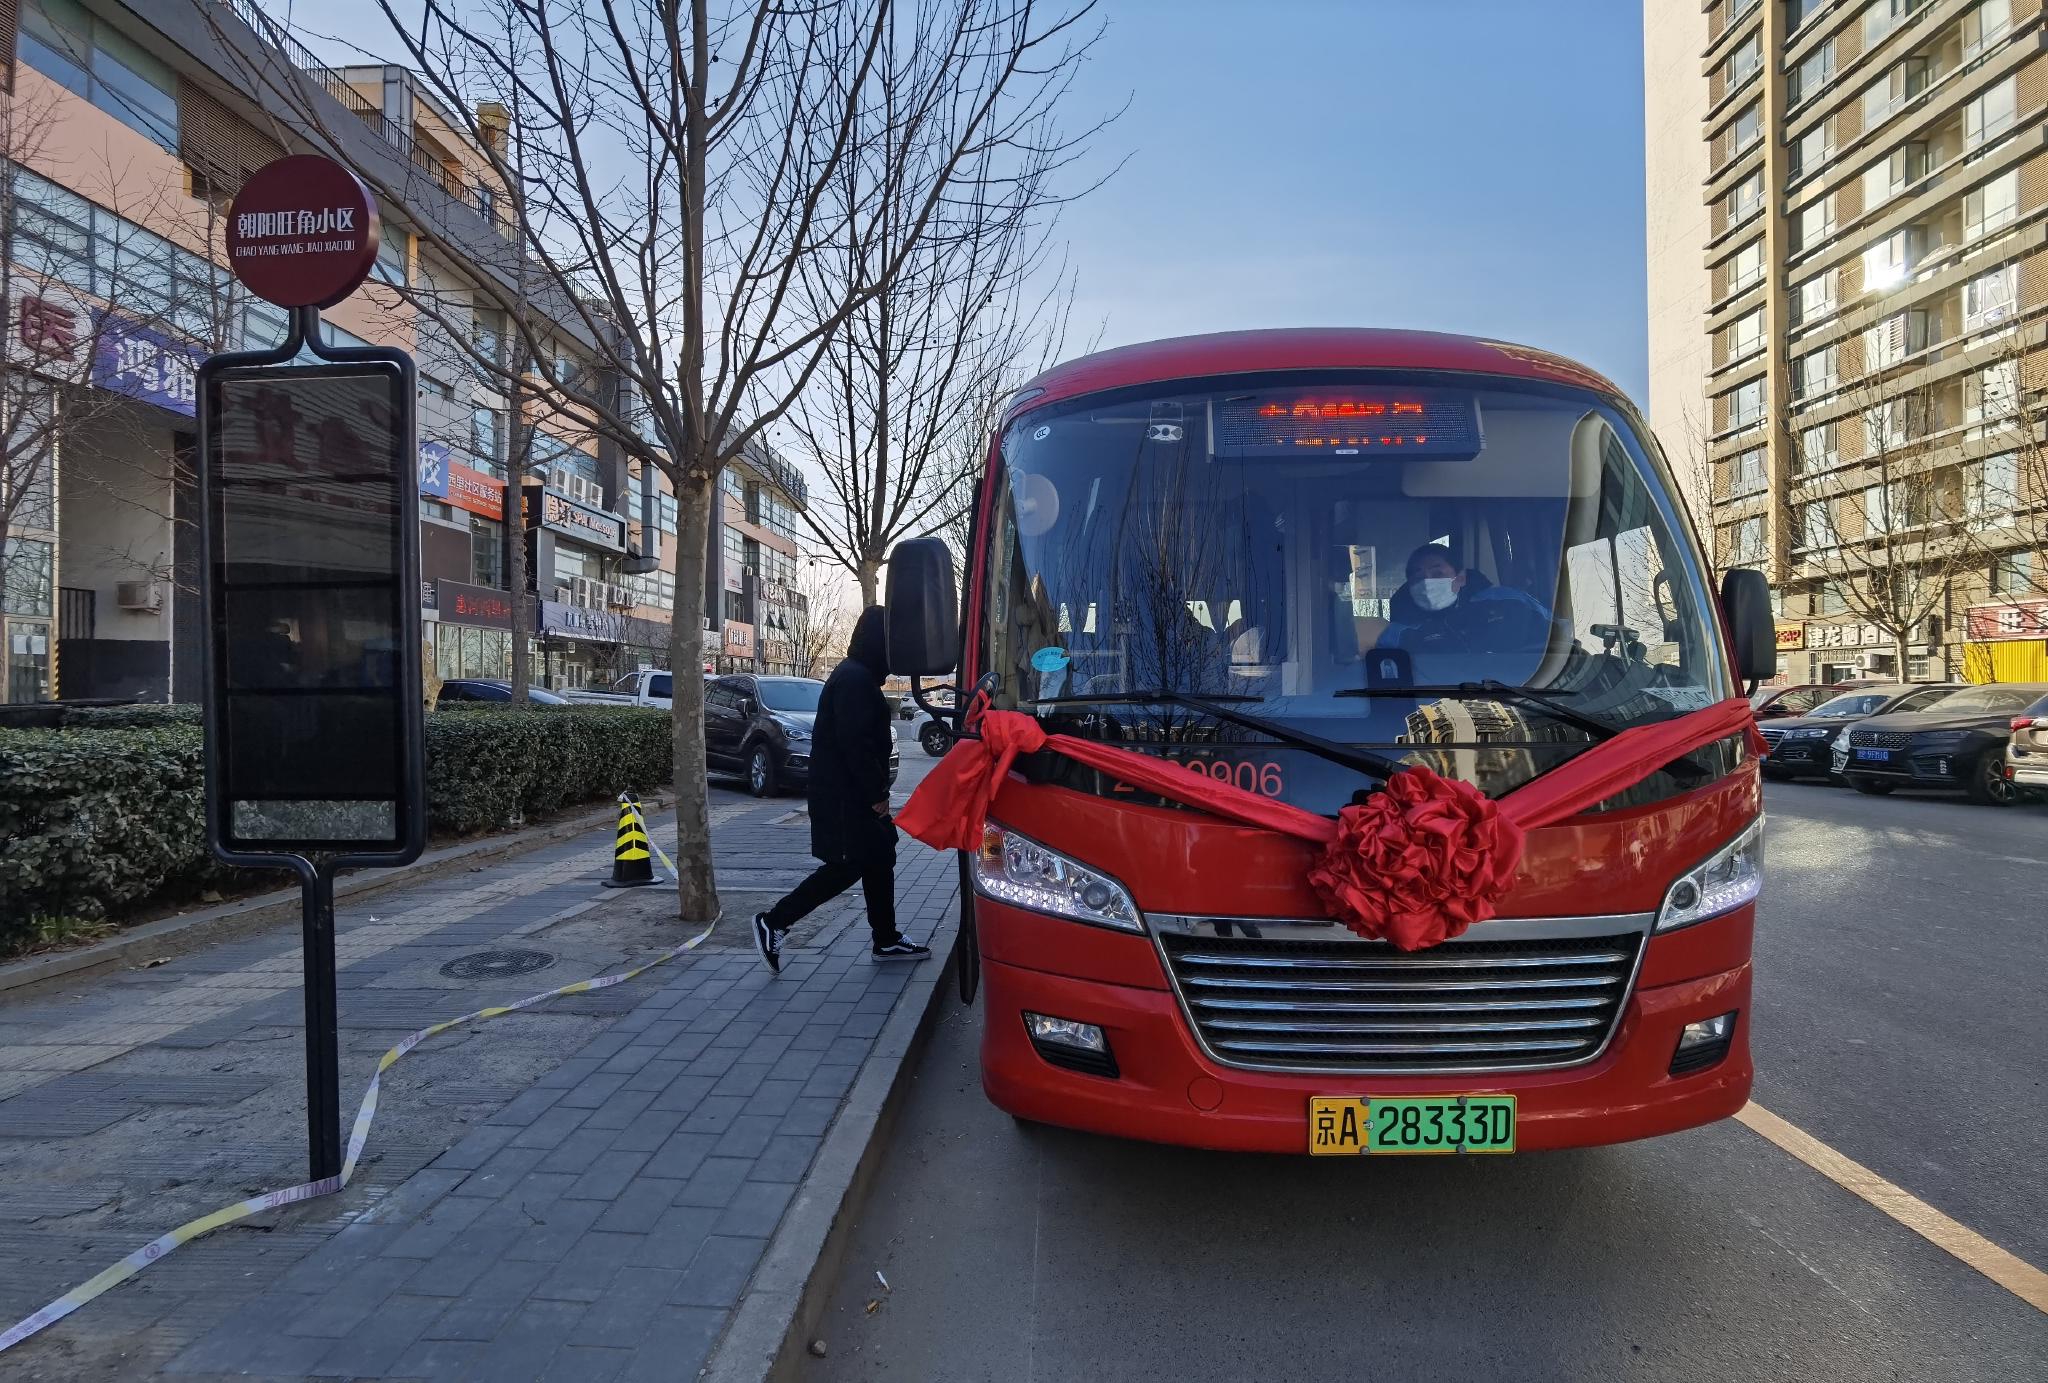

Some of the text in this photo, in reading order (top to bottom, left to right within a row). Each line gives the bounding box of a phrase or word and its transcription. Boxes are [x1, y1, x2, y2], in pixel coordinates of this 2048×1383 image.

[237, 208, 355, 238] 朝阳旺角小区
[236, 246, 257, 257] CHAO
[258, 244, 280, 256] YANG
[280, 243, 303, 254] WANG
[305, 241, 323, 253] JIAO
[325, 240, 343, 252] XIAO
[419, 447, 441, 488] 校
